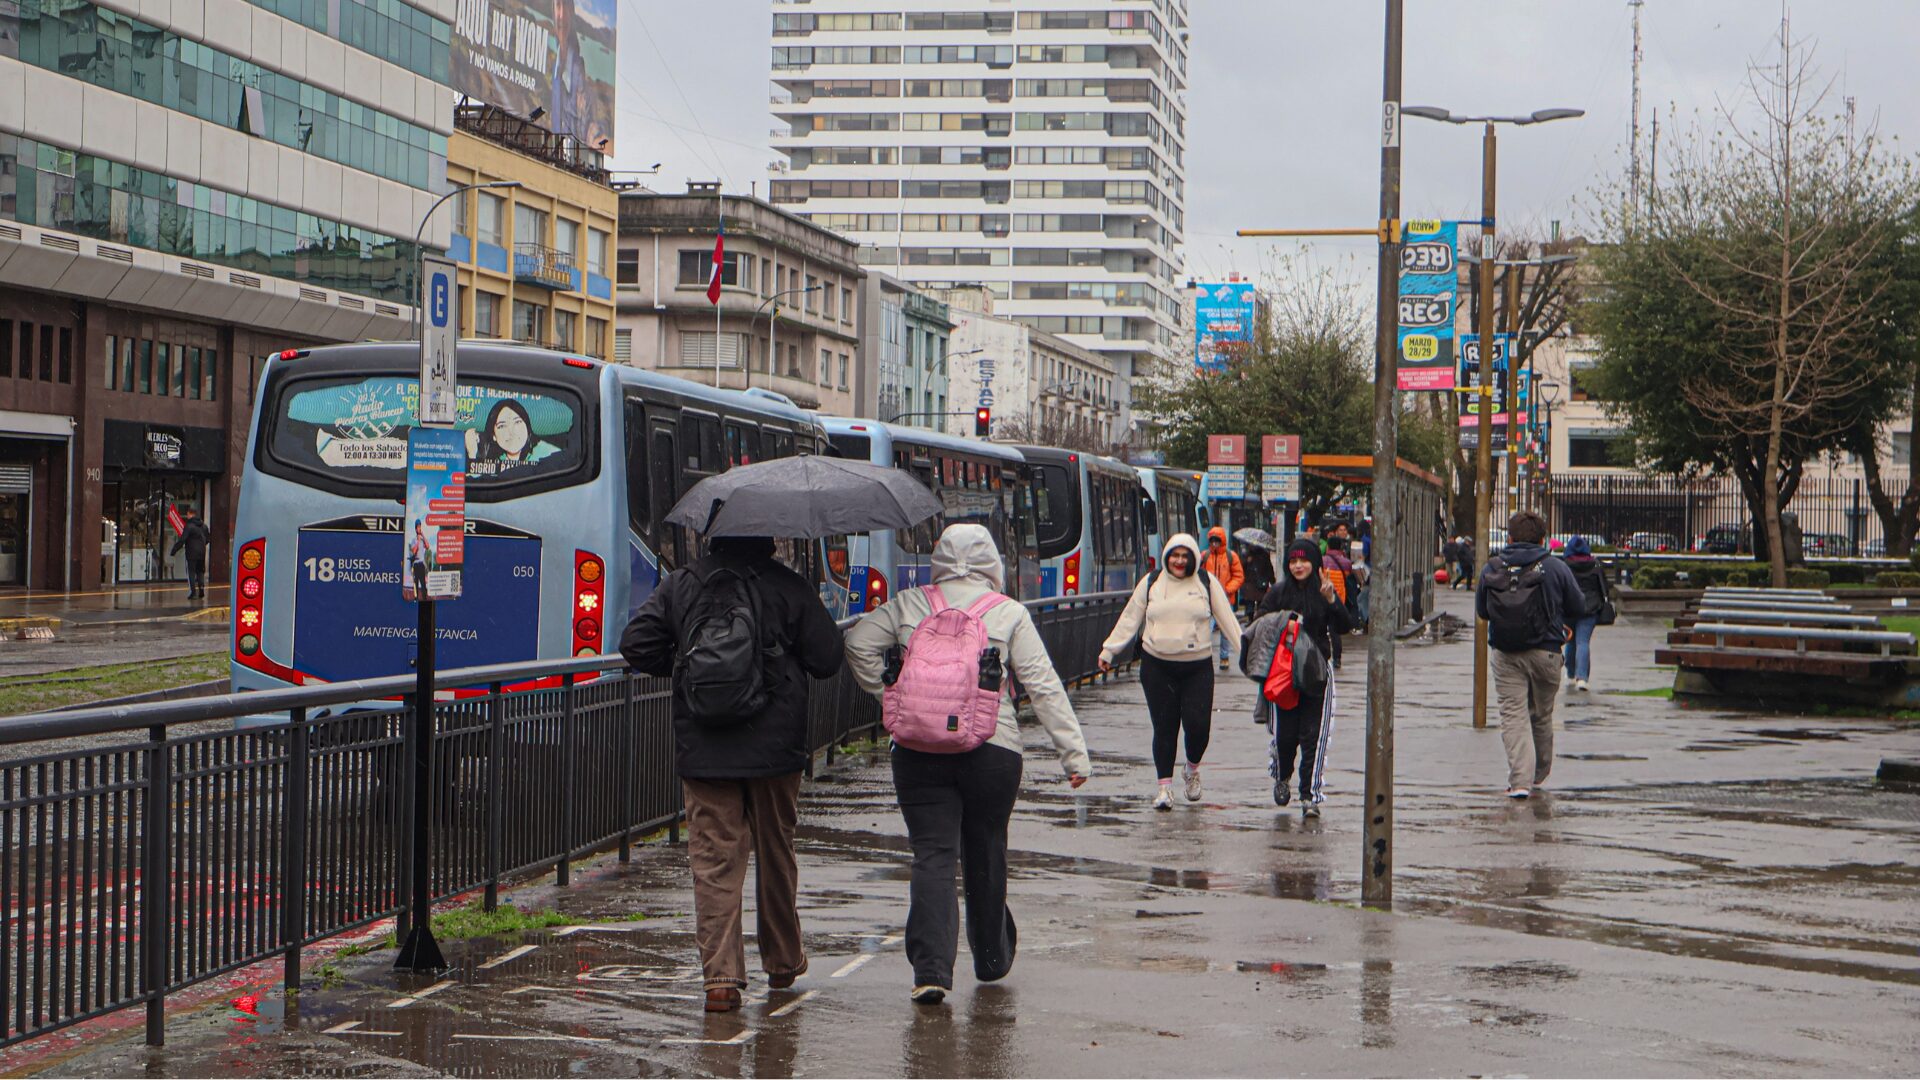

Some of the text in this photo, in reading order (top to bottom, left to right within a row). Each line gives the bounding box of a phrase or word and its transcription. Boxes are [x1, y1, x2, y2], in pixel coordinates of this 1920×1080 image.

[491, 9, 513, 52] HAY
[515, 14, 548, 75] WOM
[469, 48, 536, 91] Y NO VAMOS A PARAR
[1411, 222, 1434, 232] MARZO
[1404, 246, 1447, 266] REC
[436, 284, 444, 317] E
[1399, 303, 1441, 323] REC
[1409, 338, 1431, 346] MARZO
[1409, 347, 1431, 356] 28/29
[396, 383, 405, 395] EL
[457, 385, 473, 397] QUE
[475, 386, 485, 397] TE
[430, 402, 447, 413] SCOOTER
[153, 442, 168, 452] DECO
[339, 443, 361, 452] Todo
[362, 443, 374, 452] los
[86, 468, 100, 481] 940
[470, 462, 496, 474] SIGRID
[232, 475, 241, 488] 93
[304, 557, 335, 582] 18
[338, 559, 371, 570] BUSES
[851, 566, 865, 575] 016
[337, 571, 400, 584] PALOMARES
[512, 565, 534, 578] 050
[353, 626, 478, 640] MANTENGA STANCIA
